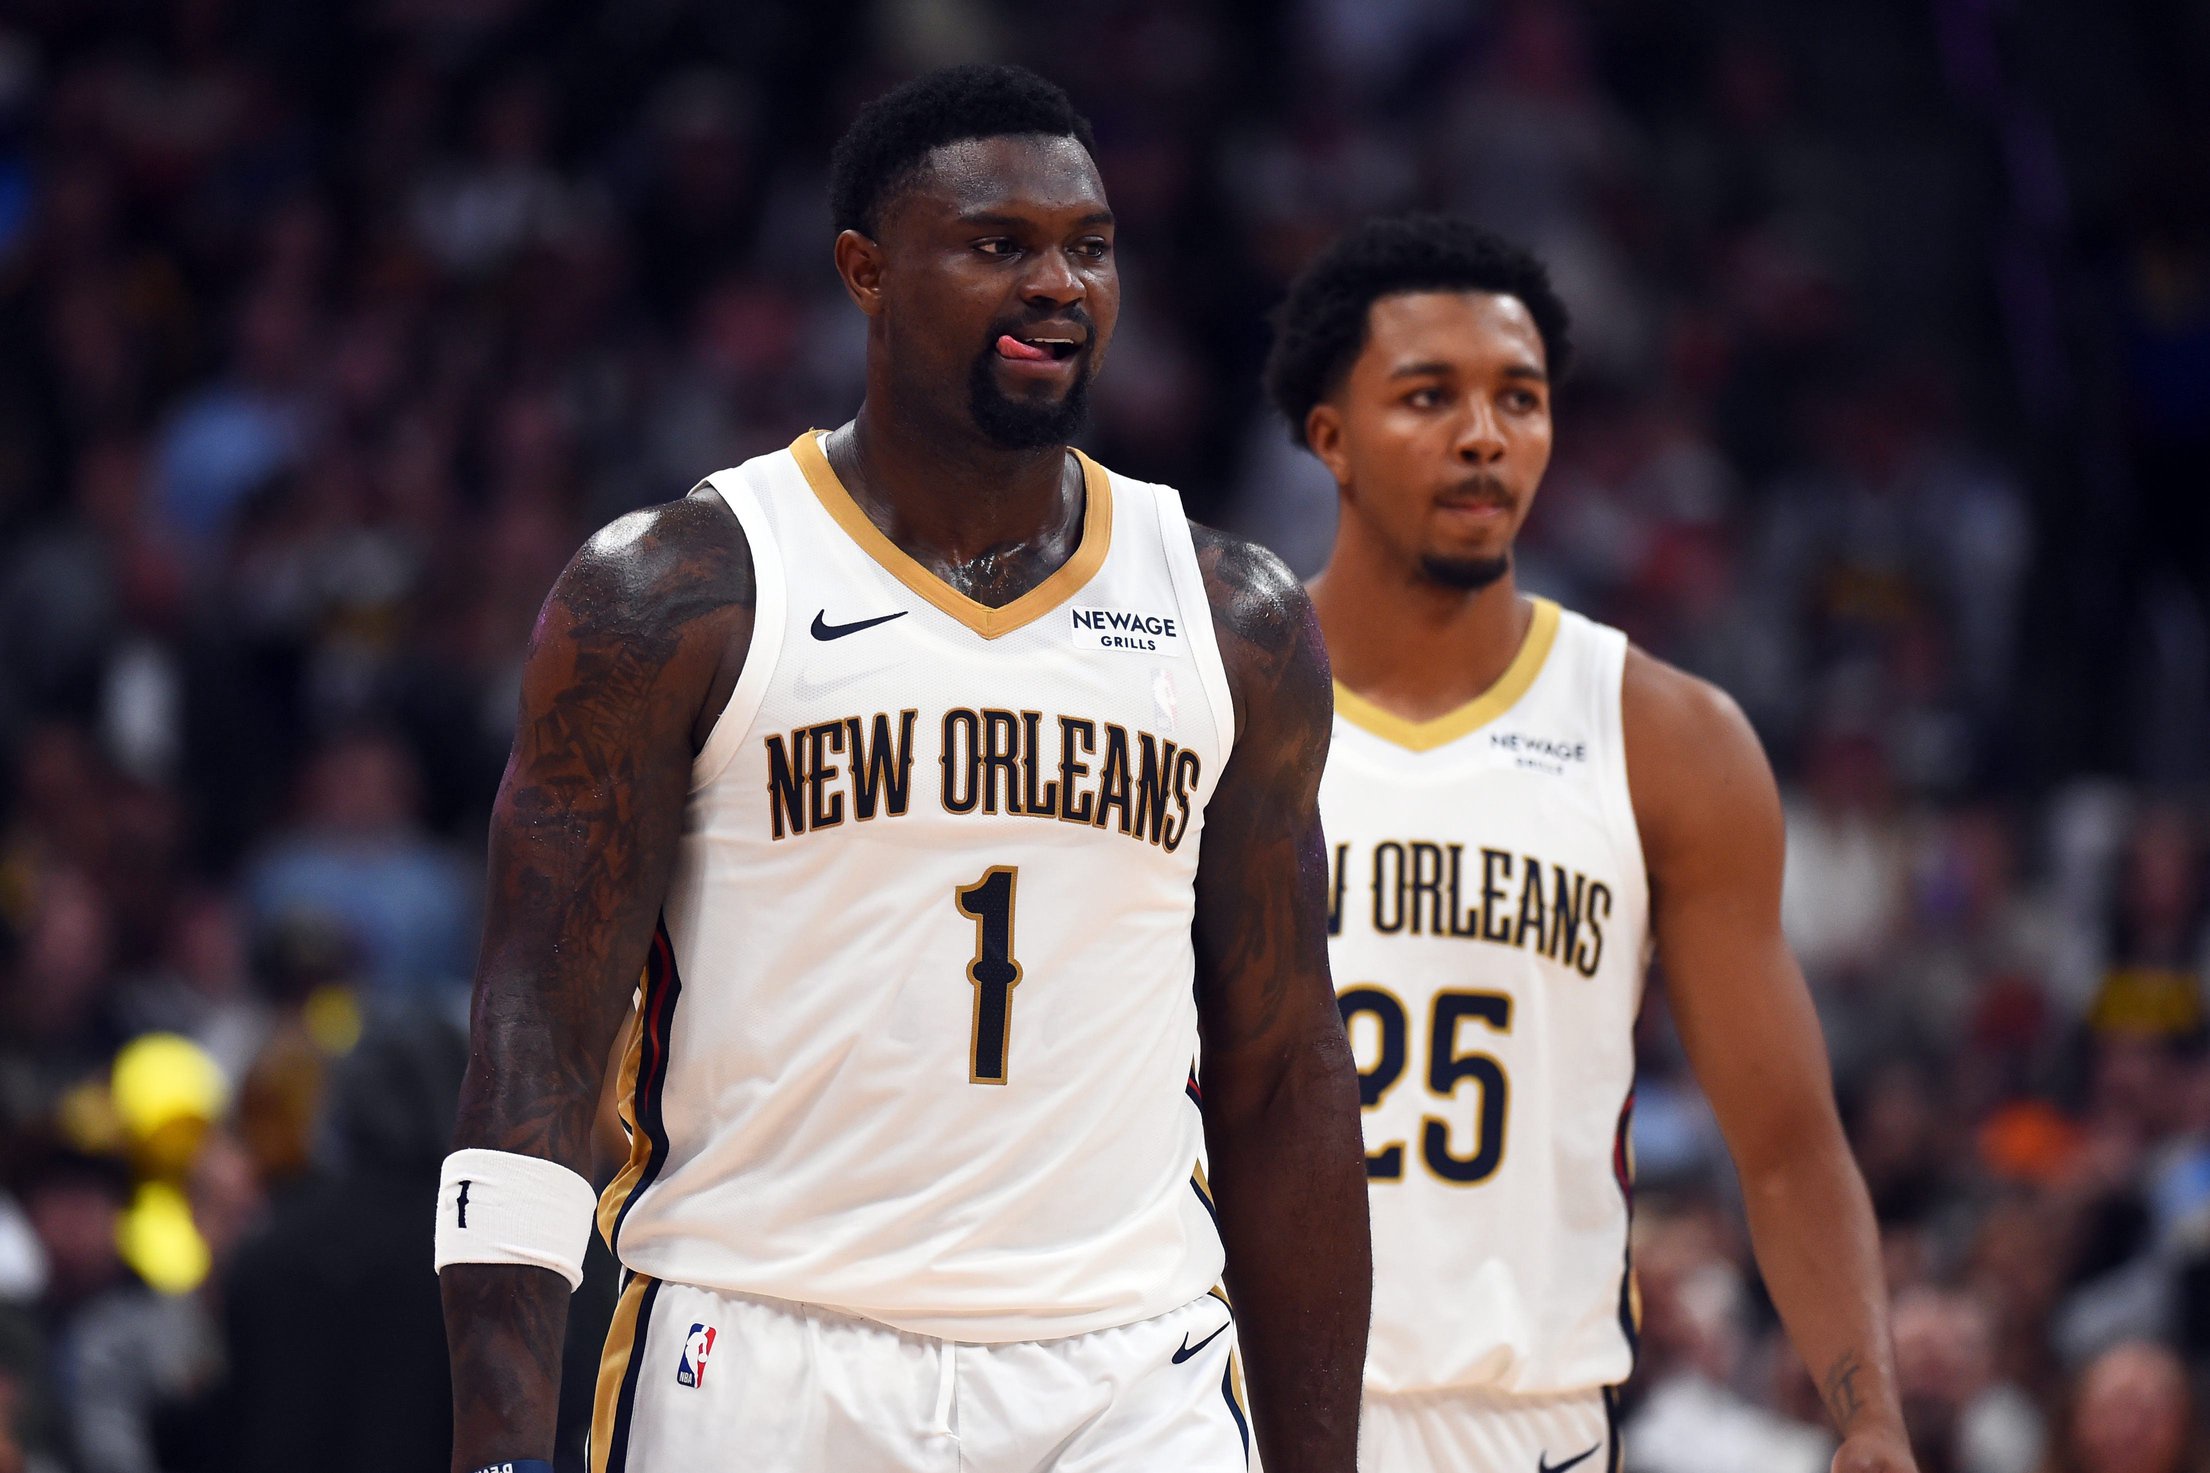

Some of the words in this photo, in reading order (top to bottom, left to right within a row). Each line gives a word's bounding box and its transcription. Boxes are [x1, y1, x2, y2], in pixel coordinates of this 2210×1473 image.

[1072, 609, 1177, 637] NEWAGE
[1100, 635, 1156, 651] GRILLS
[764, 708, 918, 841] NEW
[940, 707, 1201, 854] ORLEANS
[1490, 734, 1586, 762] NEWAGE
[1370, 839, 1612, 978] ORLEANS
[955, 864, 1023, 1085] 1
[1336, 983, 1513, 1186] 25
[679, 1371, 693, 1384] NBA
